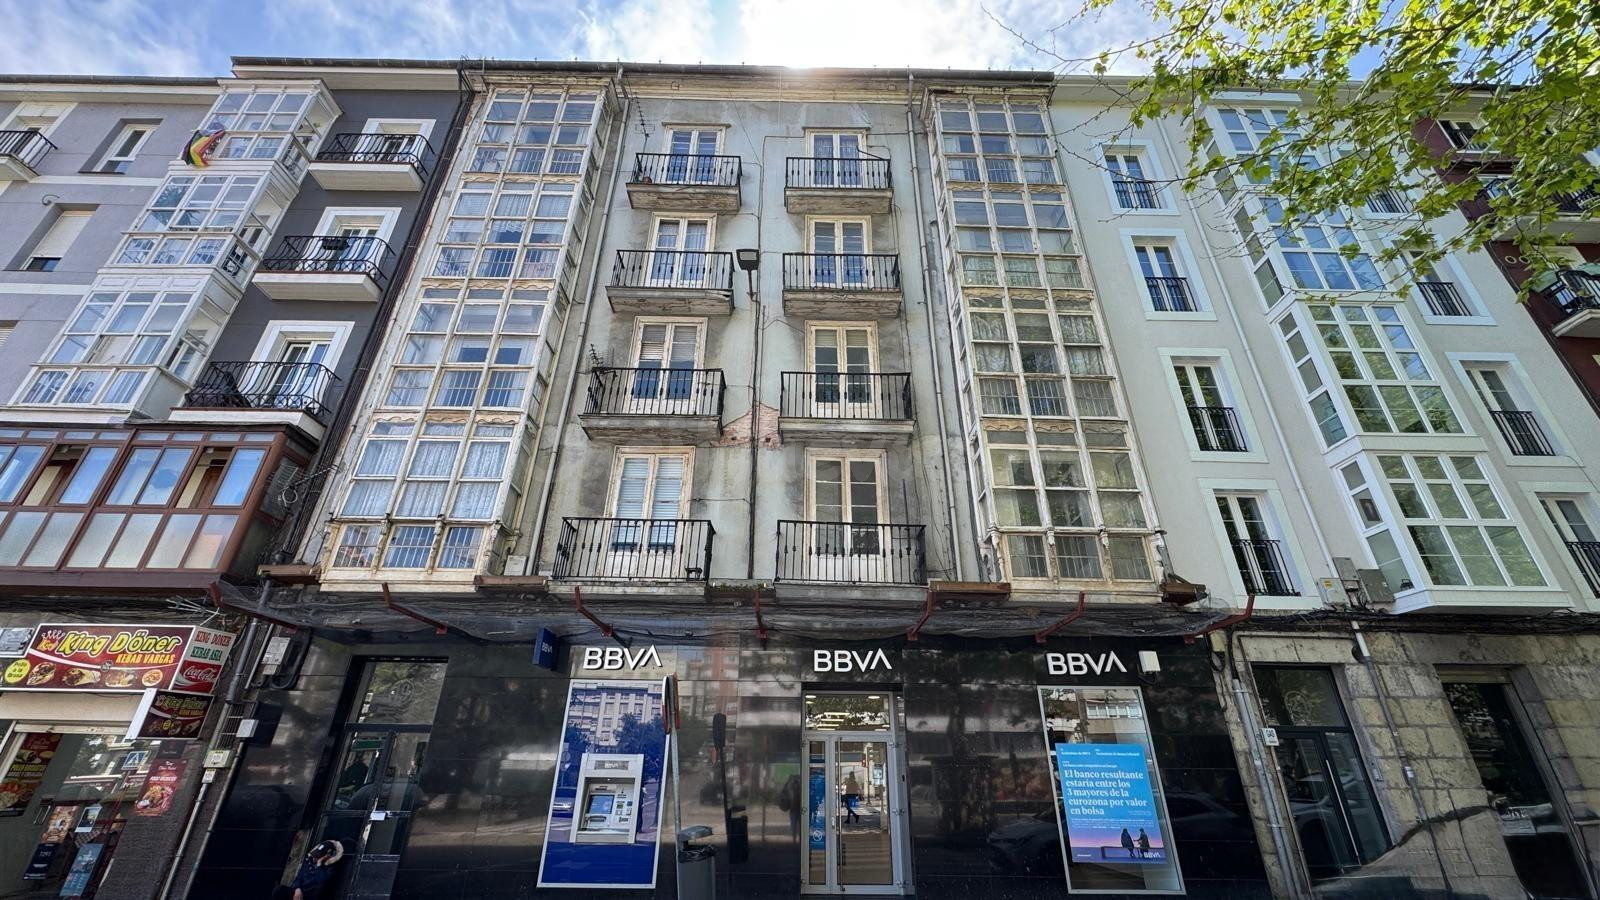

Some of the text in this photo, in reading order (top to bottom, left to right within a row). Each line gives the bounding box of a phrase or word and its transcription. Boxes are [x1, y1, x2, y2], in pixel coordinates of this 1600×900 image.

[57, 629, 182, 657] King Döner
[115, 653, 176, 664] KEBAB VARGAS
[583, 645, 663, 670] BBVA
[814, 648, 892, 673] BBVA
[1046, 650, 1127, 676] BBVA
[1064, 770, 1144, 779] El banco resultante
[1066, 779, 1131, 788] estaría entre los
[1067, 788, 1130, 798] 3 mayores de la
[1068, 798, 1147, 808] eurozona por valor
[1081, 807, 1104, 815] bolsa
